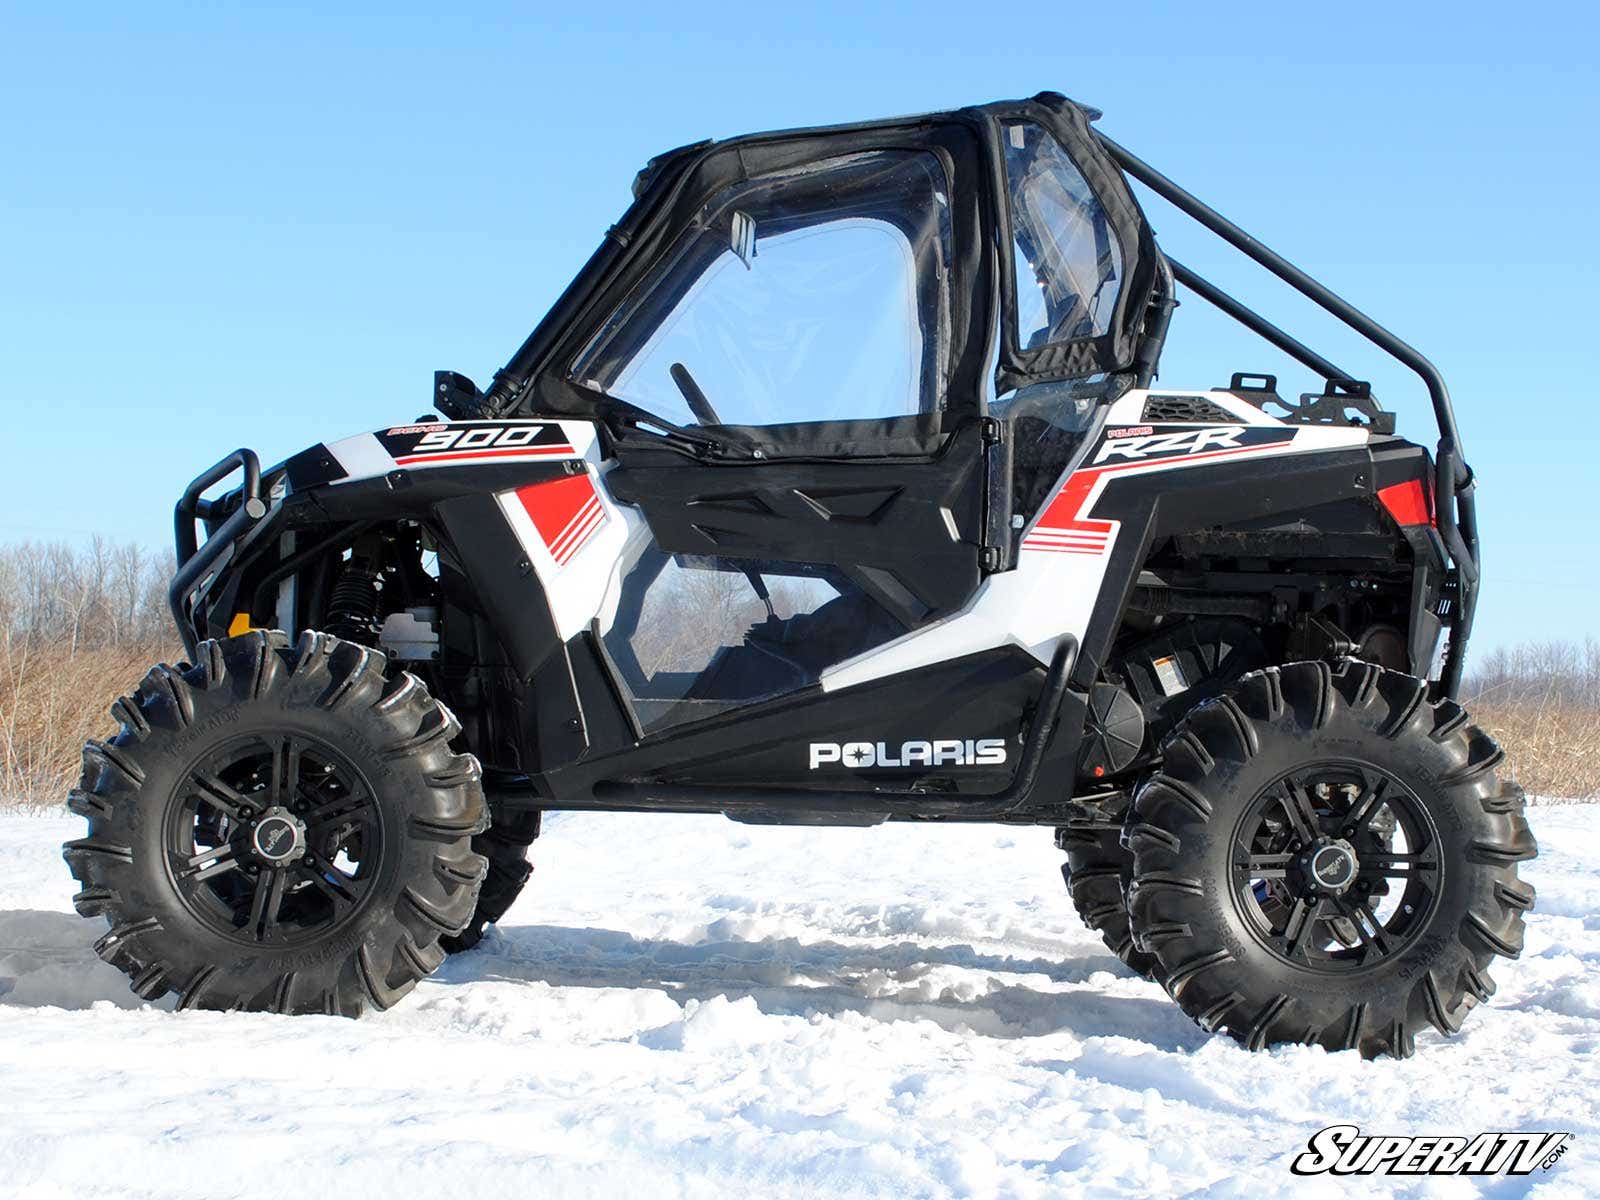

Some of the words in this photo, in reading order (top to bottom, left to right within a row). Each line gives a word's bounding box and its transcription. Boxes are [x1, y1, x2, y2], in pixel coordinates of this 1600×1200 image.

[412, 426, 543, 451] 900
[1092, 426, 1245, 464] RZR
[1107, 426, 1154, 439] POLARIS
[809, 738, 1007, 769] POLARIS
